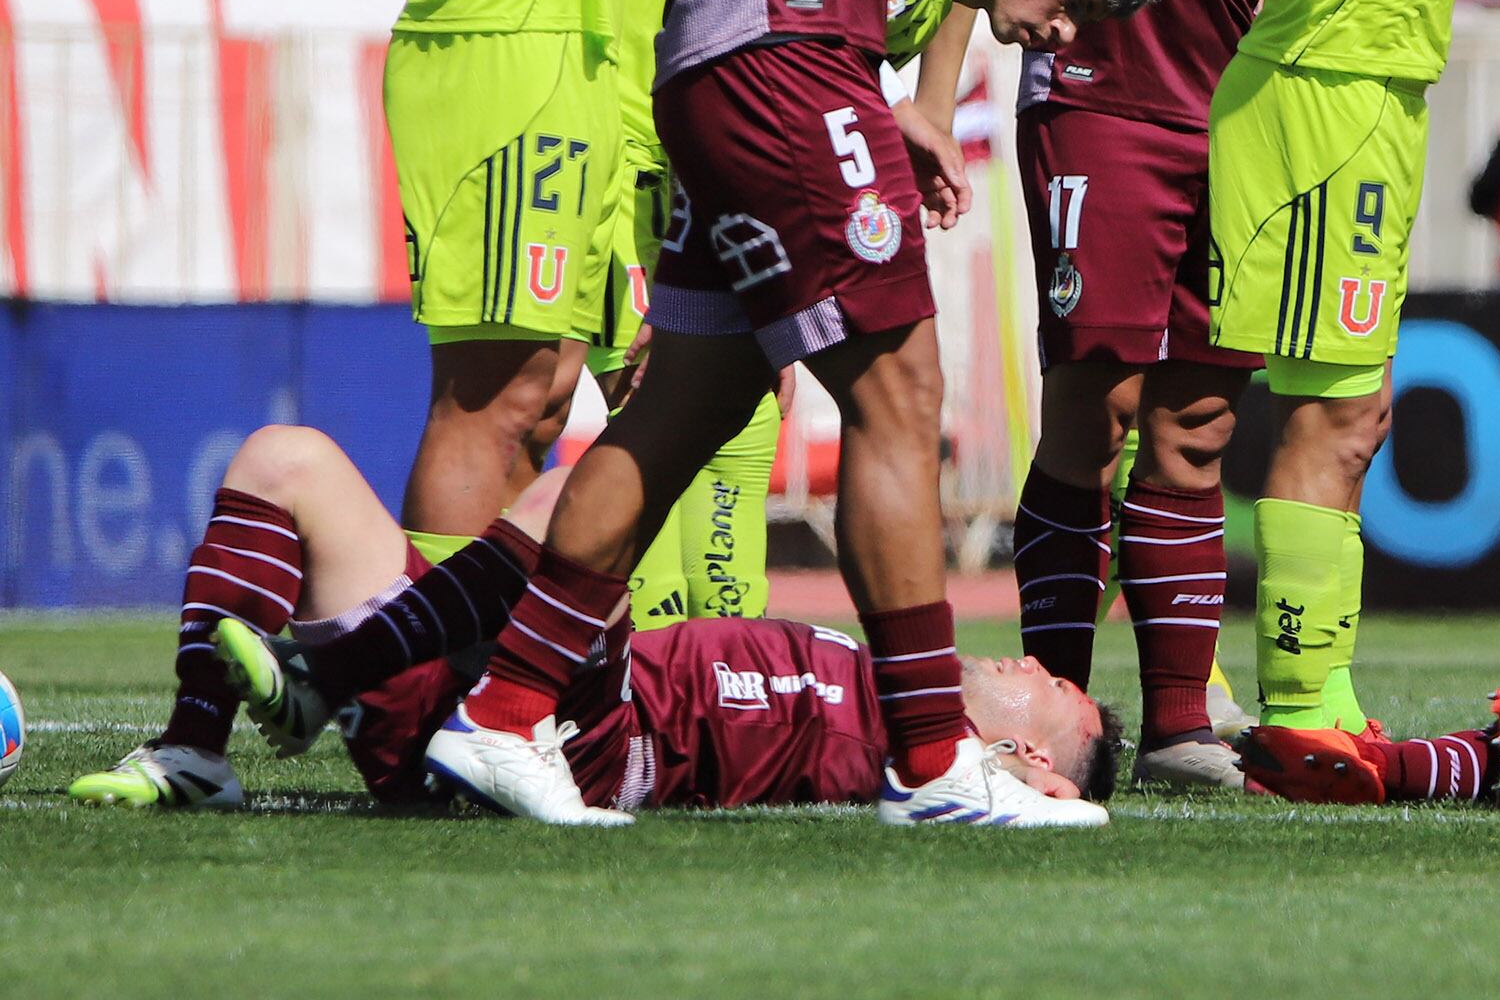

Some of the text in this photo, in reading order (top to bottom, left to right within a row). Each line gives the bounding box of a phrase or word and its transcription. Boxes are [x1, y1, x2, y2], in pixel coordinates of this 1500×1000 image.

[823, 107, 876, 188] 5
[1048, 176, 1089, 249] 17
[1353, 183, 1385, 254] 9
[527, 243, 568, 304] U
[1338, 277, 1387, 336] U
[769, 672, 843, 705] Mining
